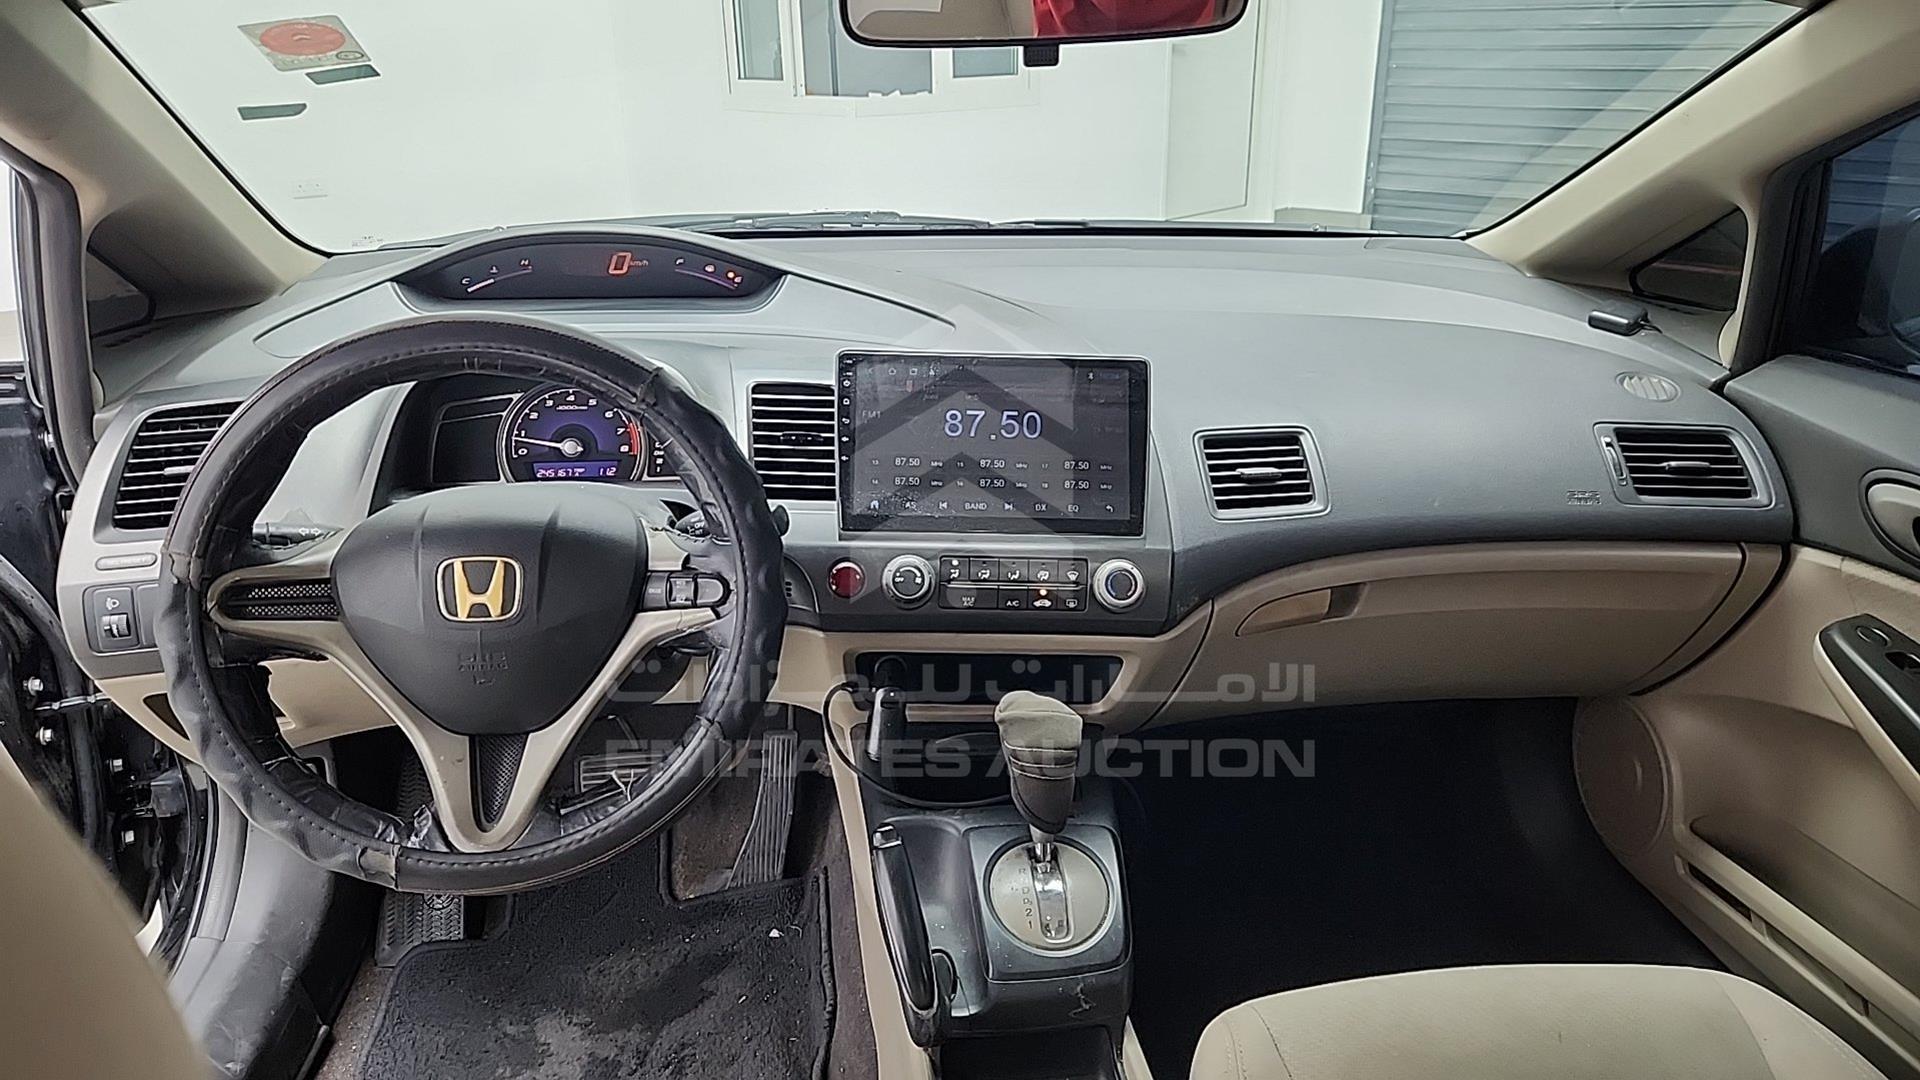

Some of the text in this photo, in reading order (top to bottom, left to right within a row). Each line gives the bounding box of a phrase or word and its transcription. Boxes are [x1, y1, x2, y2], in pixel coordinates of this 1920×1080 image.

[608, 252, 632, 274] 0
[944, 410, 1042, 439] 87.50
[895, 458, 920, 466] 87.50
[980, 460, 1005, 468] 87.50
[1064, 461, 1090, 470] 87.50
[895, 477, 920, 485] 87.50
[980, 479, 1005, 487] 87.50
[1064, 481, 1090, 489] 87.50
[1035, 503, 1047, 511] DX
[1068, 505, 1079, 513] EQ
[1025, 908, 1033, 917] 2
[1028, 920, 1033, 930] 1
